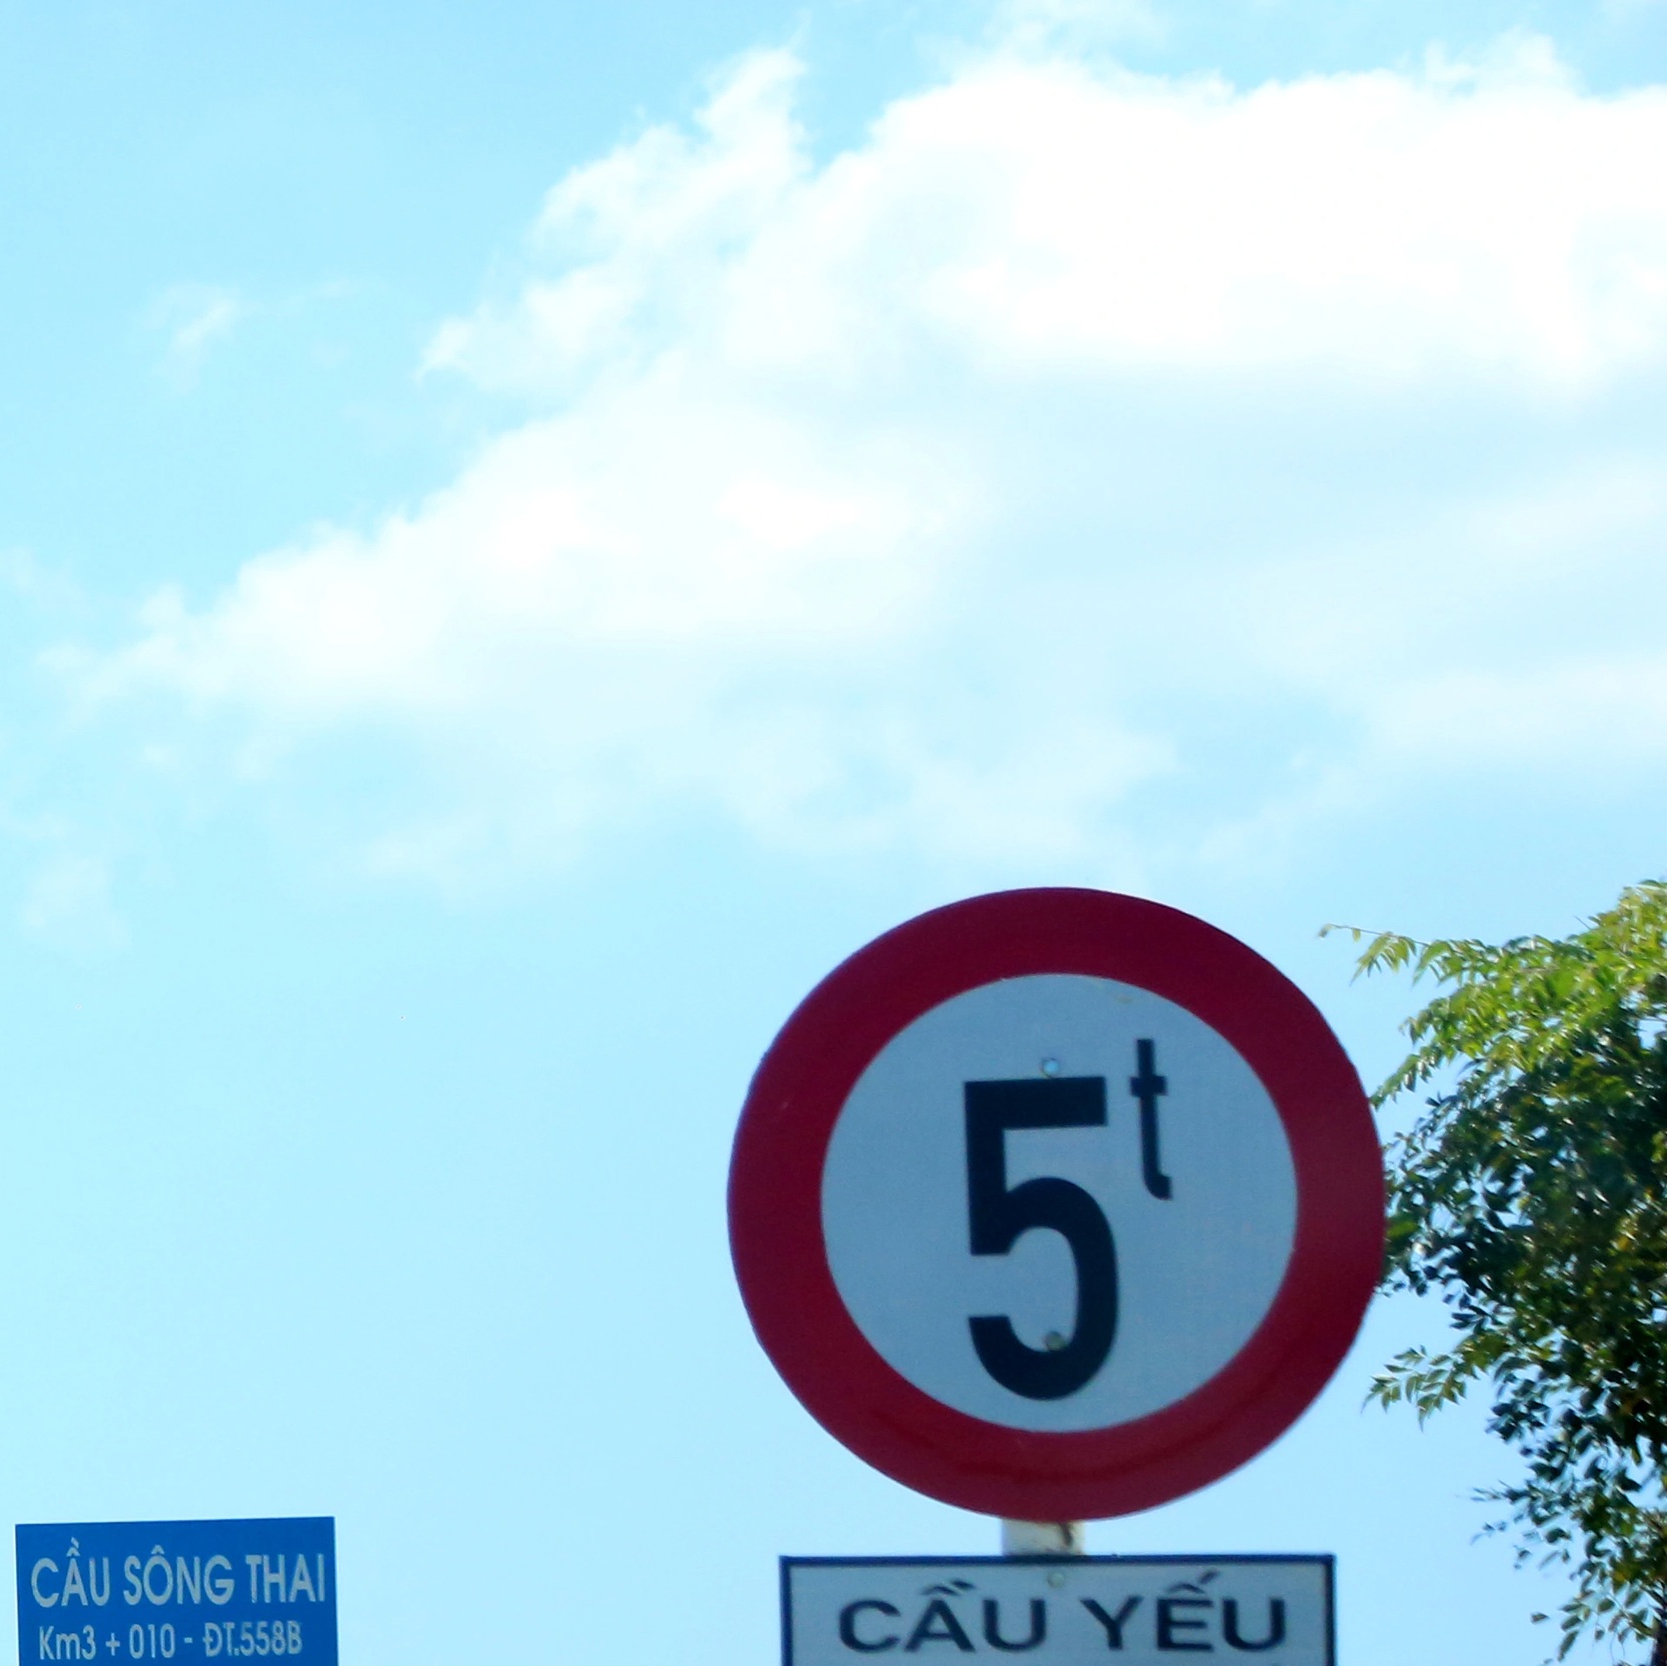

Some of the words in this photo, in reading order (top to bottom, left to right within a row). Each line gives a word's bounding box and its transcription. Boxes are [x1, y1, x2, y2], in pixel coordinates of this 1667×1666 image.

[30, 1537, 111, 1608] CẦU
[123, 1544, 235, 1606] SÔNG
[245, 1553, 326, 1604] THAI
[38, 1625, 97, 1660] Km3
[129, 1623, 176, 1659] 010
[202, 1620, 303, 1657] ĐT.558B
[838, 1579, 1047, 1653] CẦU
[1081, 1570, 1287, 1652] YẾU
